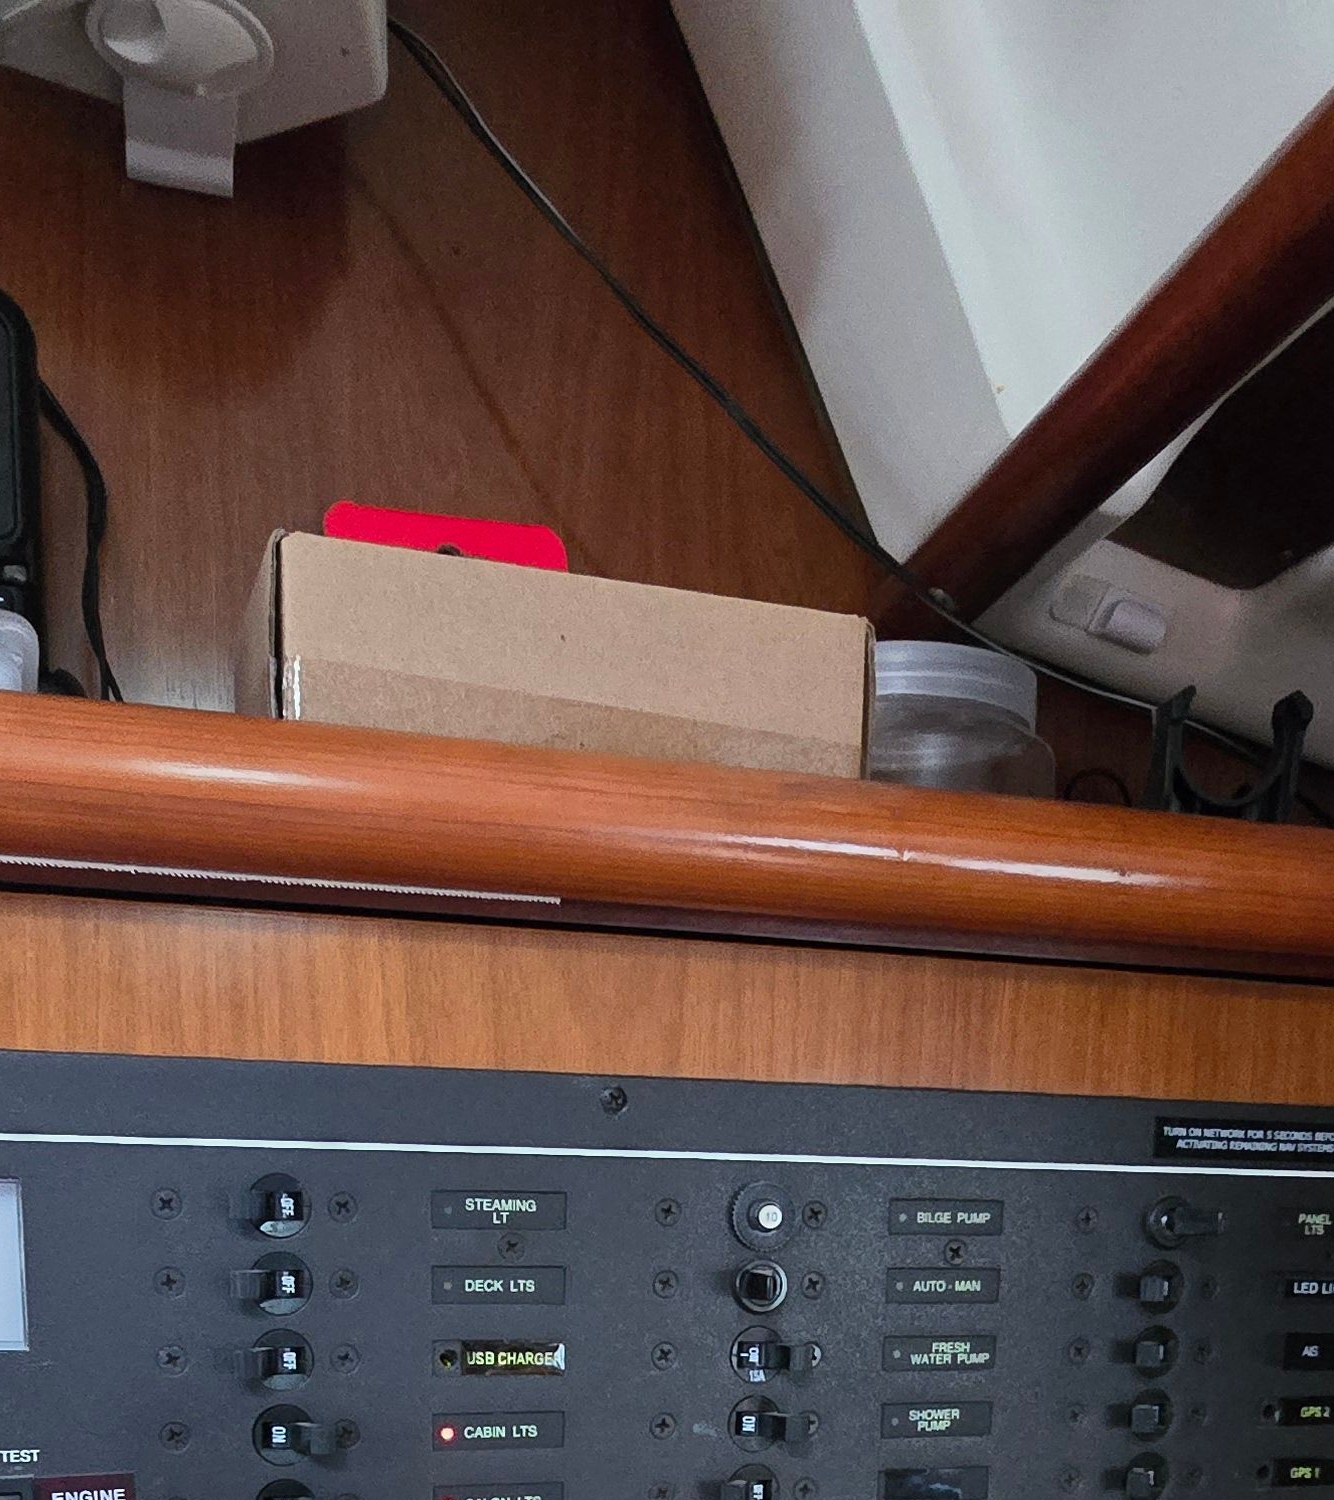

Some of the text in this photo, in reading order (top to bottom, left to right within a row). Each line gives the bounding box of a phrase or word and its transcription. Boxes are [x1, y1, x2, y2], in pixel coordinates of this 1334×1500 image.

[464, 1198, 537, 1213] STEAMING
[492, 1212, 508, 1225] LT
[916, 1211, 990, 1224] BILGE PUMP
[1298, 1213, 1332, 1225] PANEL
[1305, 1224, 1325, 1236] LTS
[464, 1279, 536, 1293] DECK LTS
[913, 1280, 981, 1292] AUTO MAN
[1293, 1281, 1319, 1294] LED
[910, 1342, 990, 1365] FRESH WATER PUMP
[1302, 1345, 1319, 1358] AIS
[467, 1351, 559, 1367] USB CHARGE
[909, 1408, 960, 1432] SHOWER PUMP
[463, 1425, 538, 1440] CABIN LTS
[0, 1448, 40, 1463] TEST
